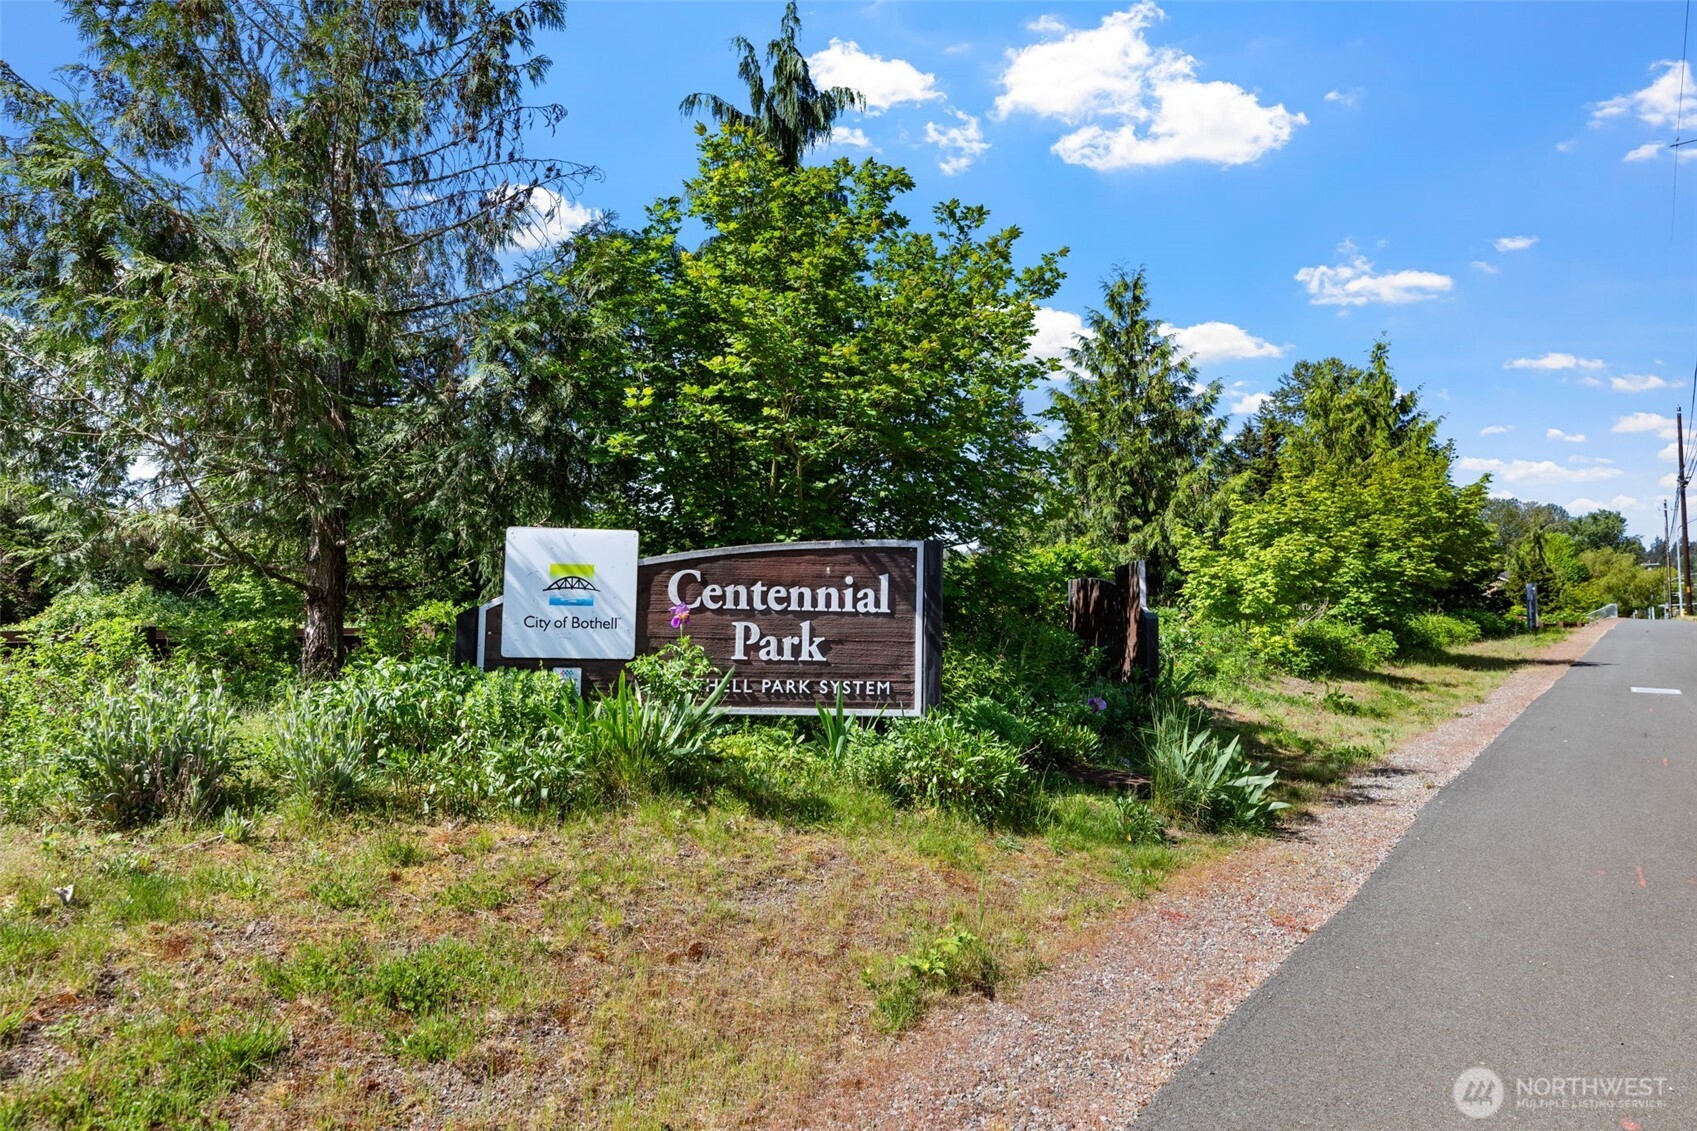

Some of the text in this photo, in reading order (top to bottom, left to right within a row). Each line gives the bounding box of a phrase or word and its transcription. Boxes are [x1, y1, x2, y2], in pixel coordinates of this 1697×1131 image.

[667, 569, 890, 613] Centennial
[523, 615, 618, 632] City of Bothell
[731, 620, 827, 662] Park
[761, 679, 811, 694] PARK
[819, 680, 890, 695] SYSTEM
